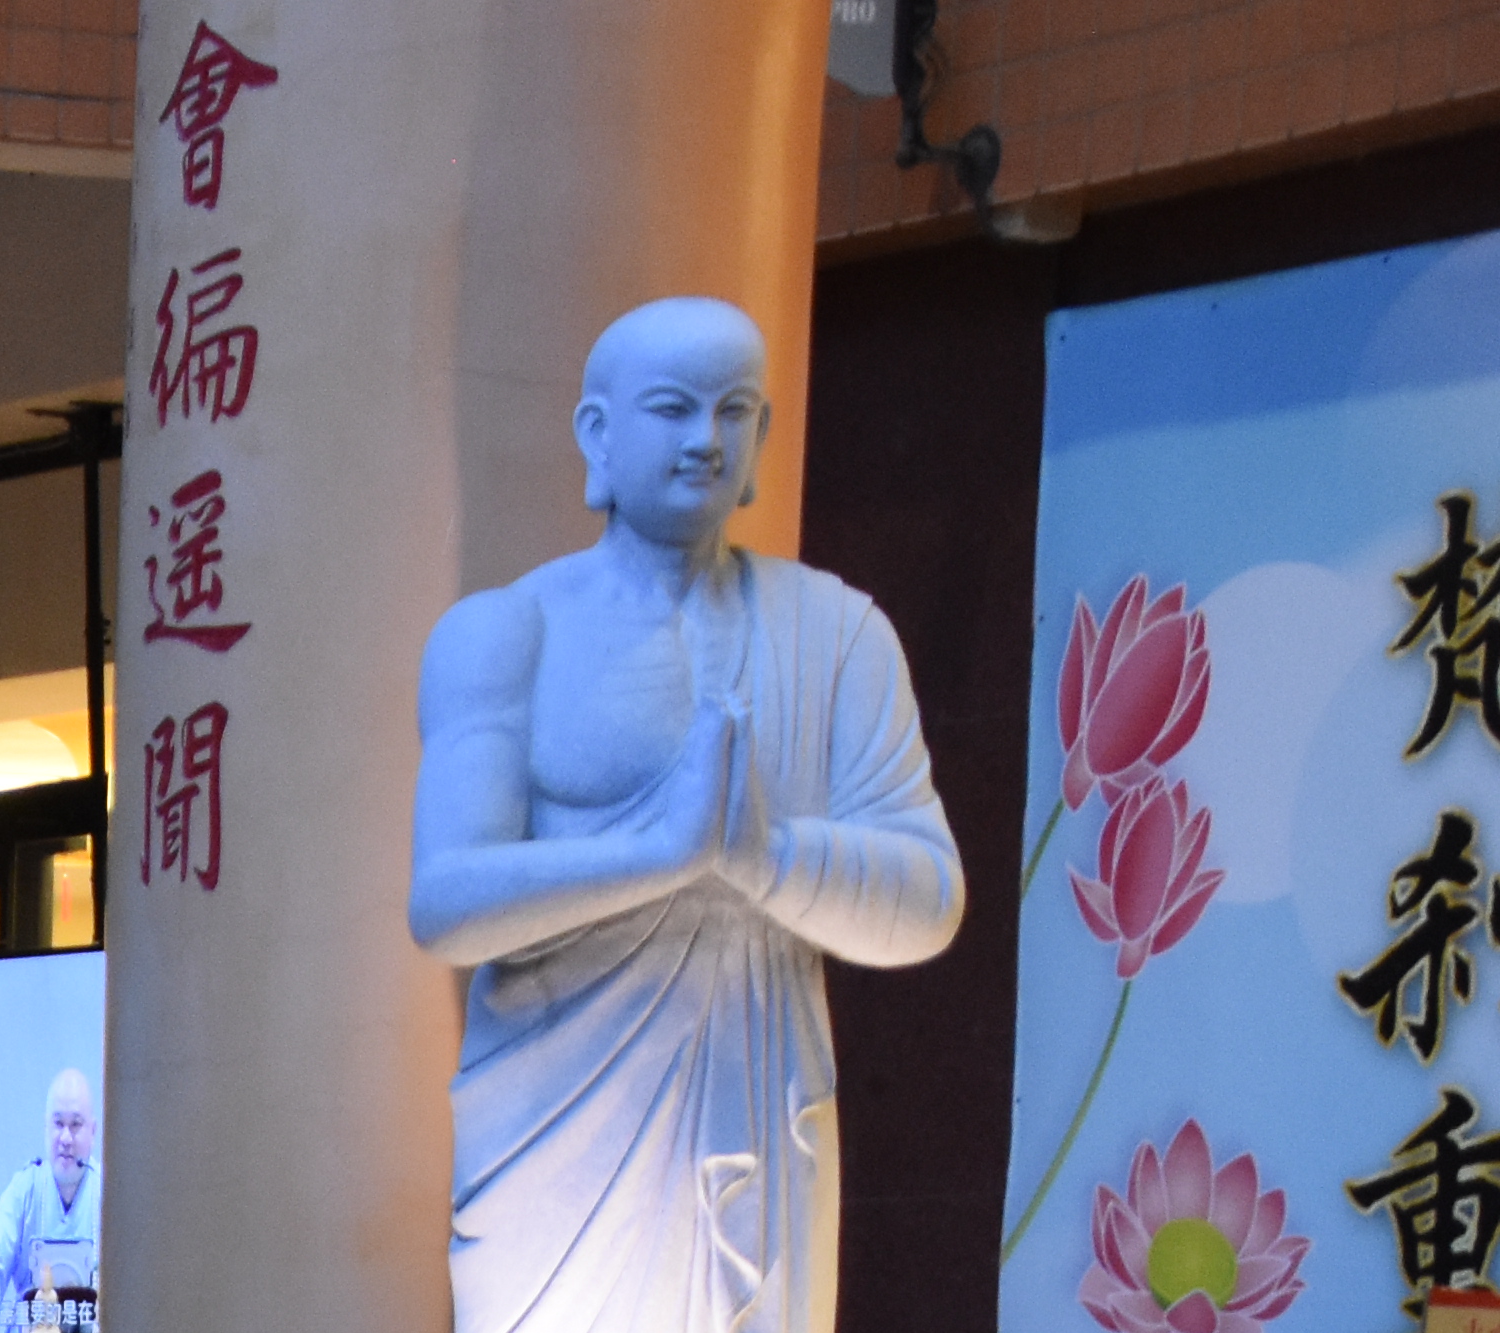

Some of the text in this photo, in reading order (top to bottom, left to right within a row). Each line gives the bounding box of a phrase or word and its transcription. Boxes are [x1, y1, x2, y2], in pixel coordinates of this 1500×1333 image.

[0, 1299, 100, 1326] 最重要的是在
